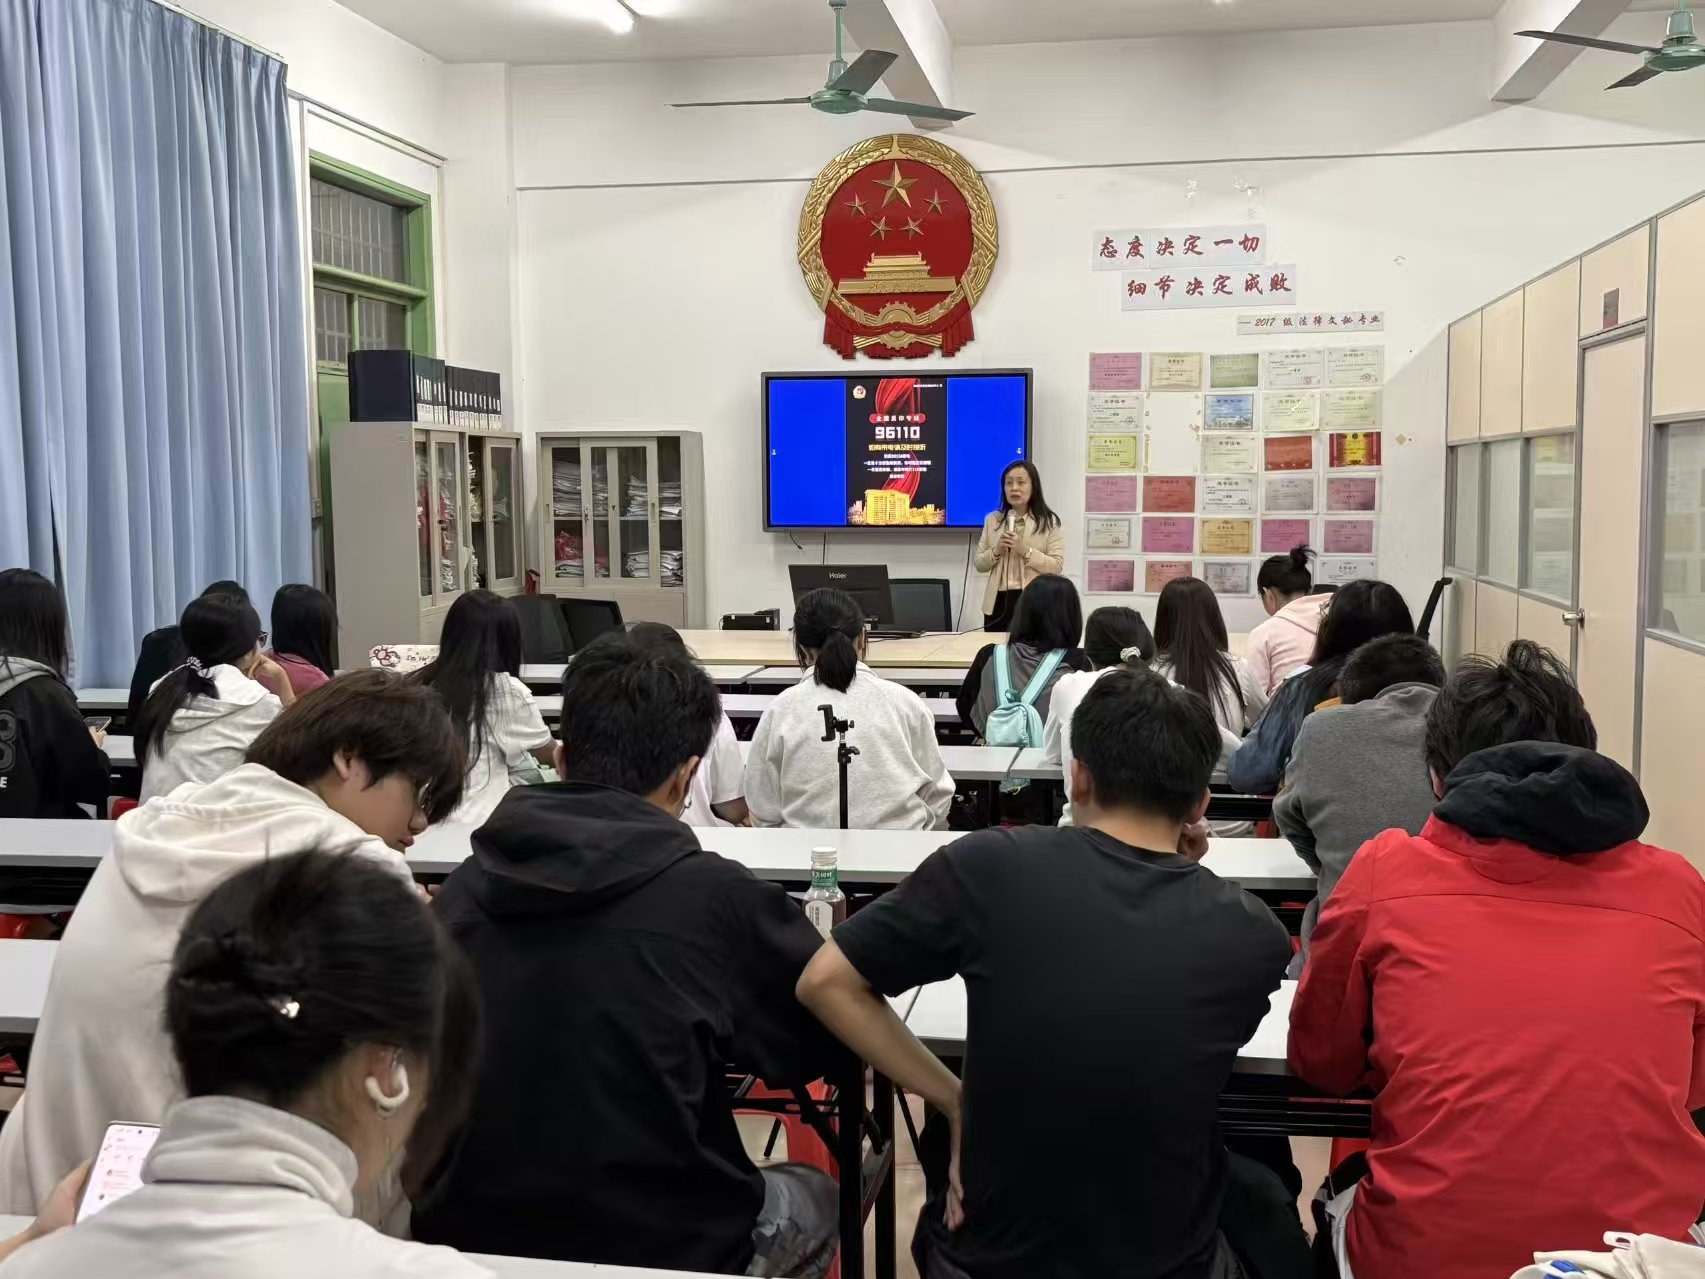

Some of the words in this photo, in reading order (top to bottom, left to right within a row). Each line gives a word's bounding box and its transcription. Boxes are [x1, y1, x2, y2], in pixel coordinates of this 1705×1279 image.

[1099, 233, 1260, 259] 态度决定一切
[1127, 272, 1292, 300] 细节决定成败
[875, 426, 920, 439] 96110
